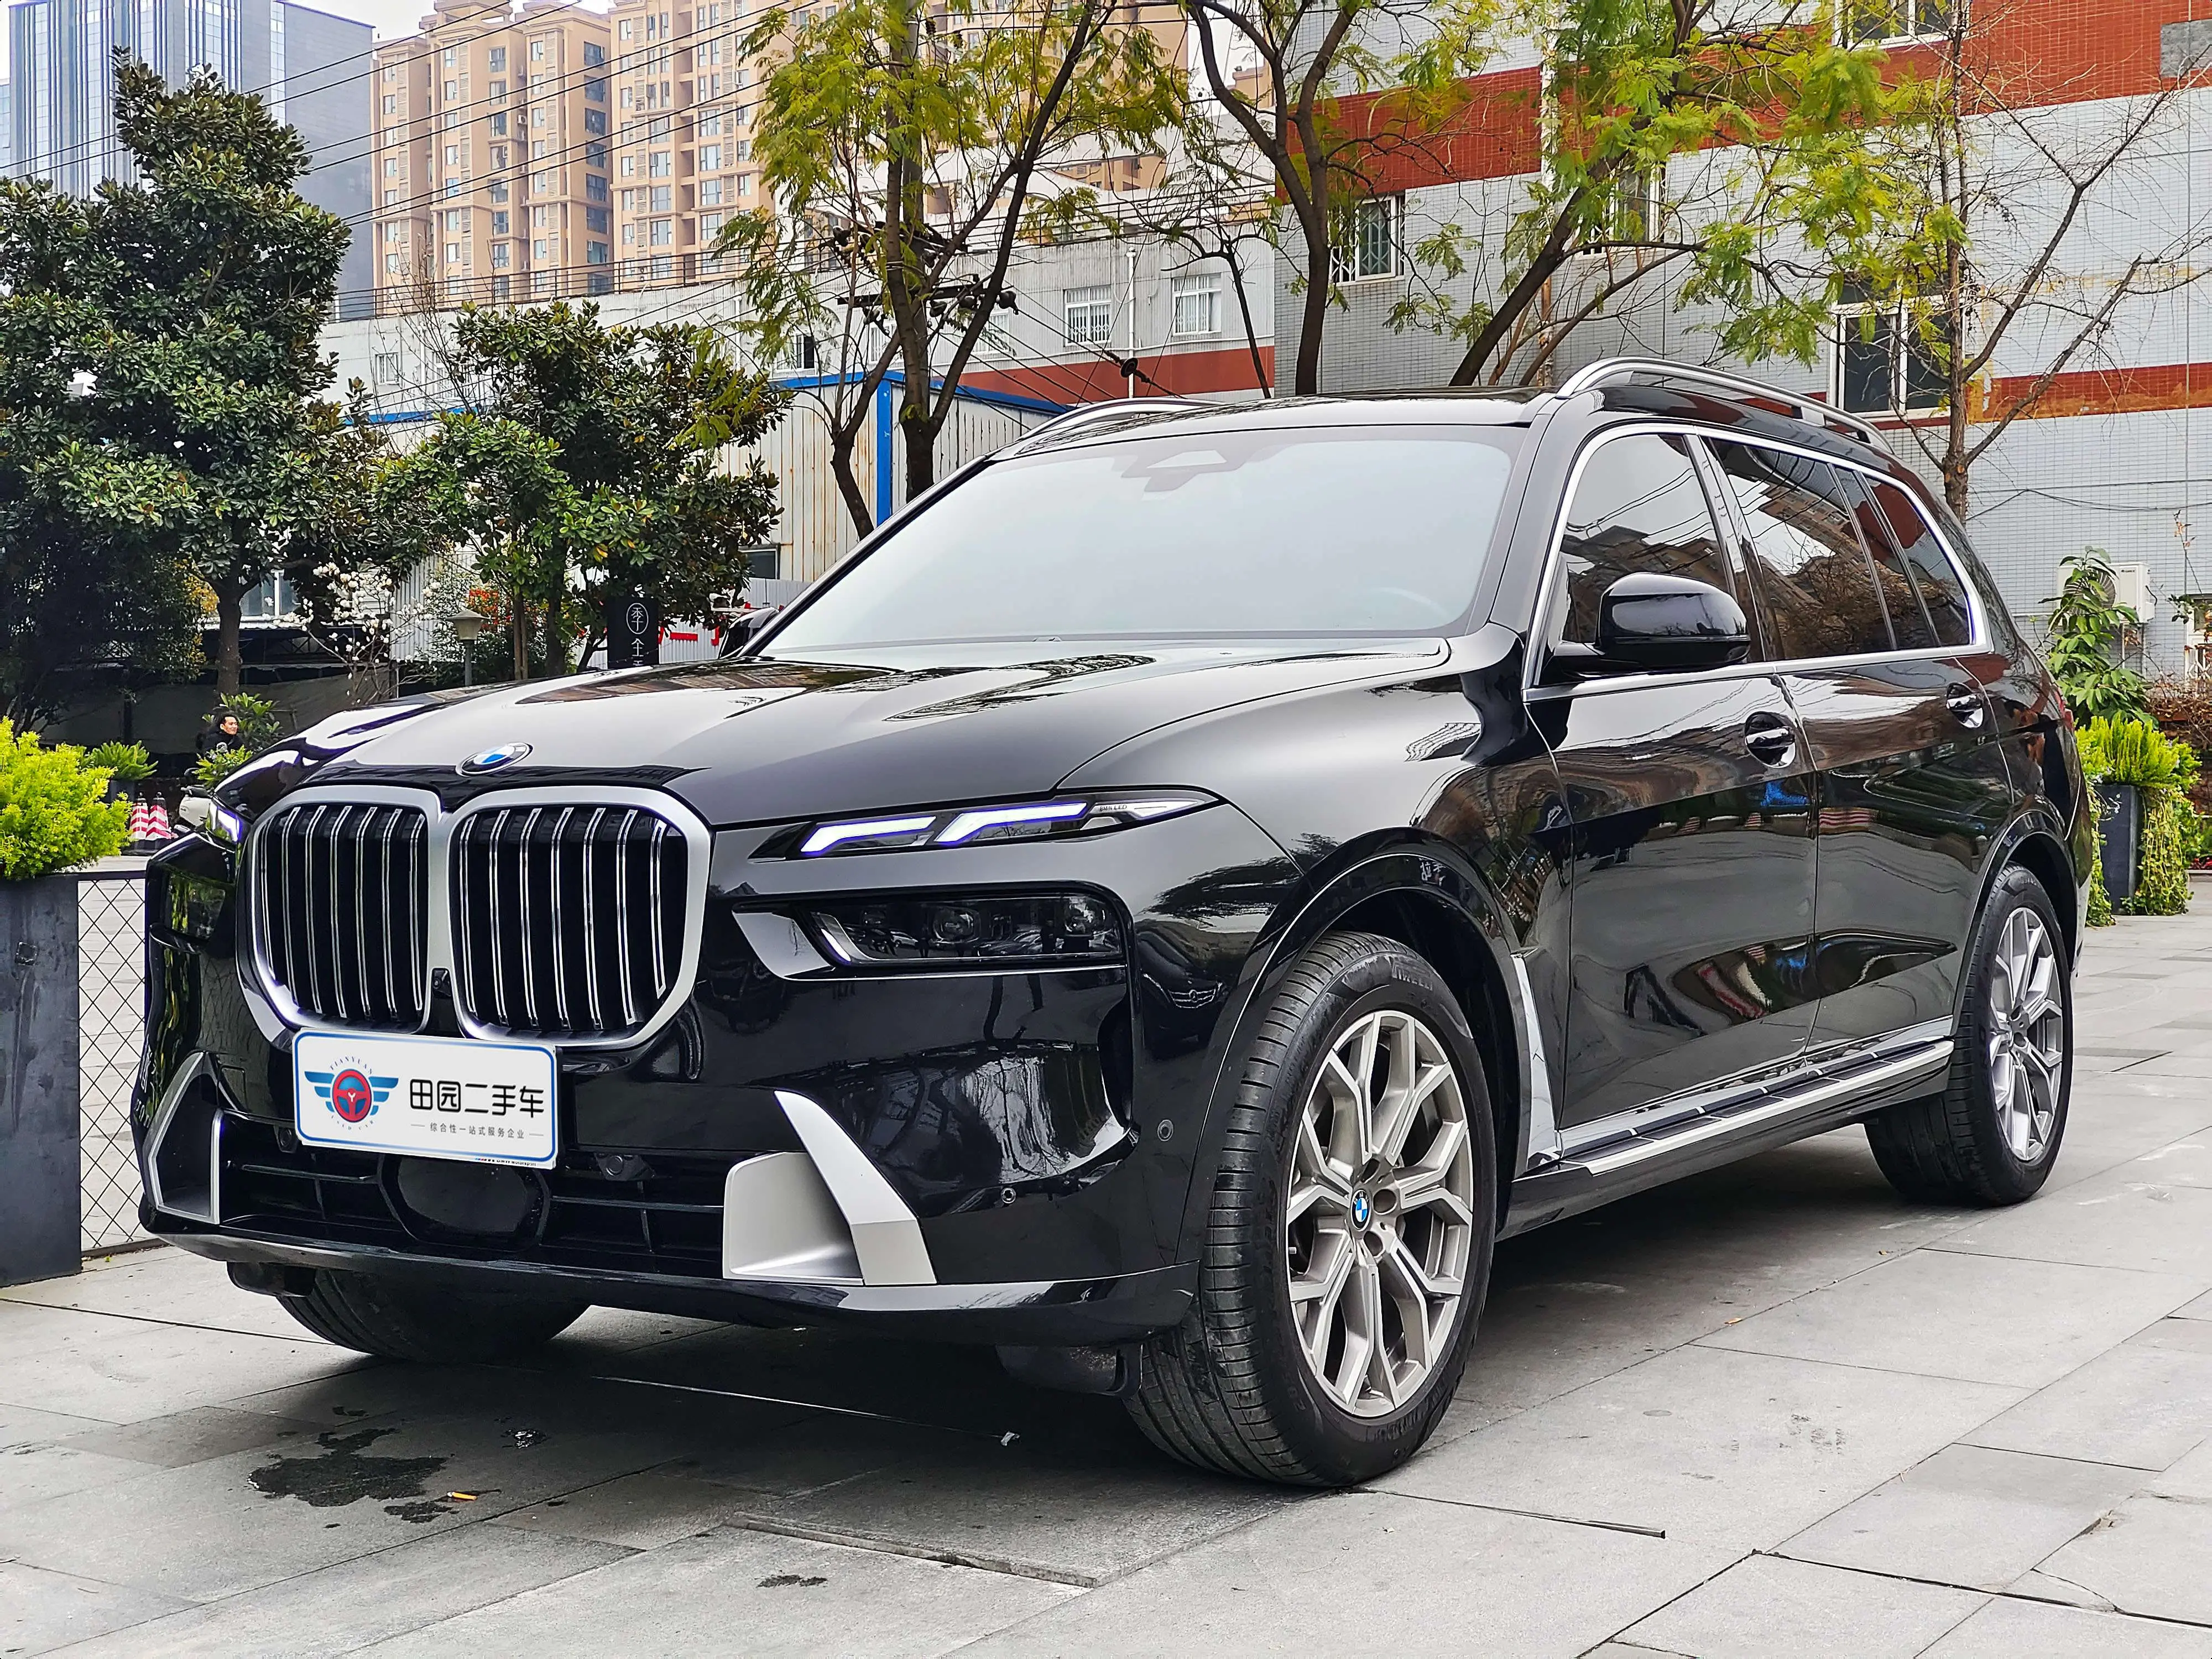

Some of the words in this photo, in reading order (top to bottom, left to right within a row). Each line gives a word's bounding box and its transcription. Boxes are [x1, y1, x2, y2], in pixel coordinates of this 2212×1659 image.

[347, 1092, 356, 1103] Y
[410, 1078, 544, 1119] 田园二手车
[430, 1122, 525, 1139] 综合性一站式服务企业
